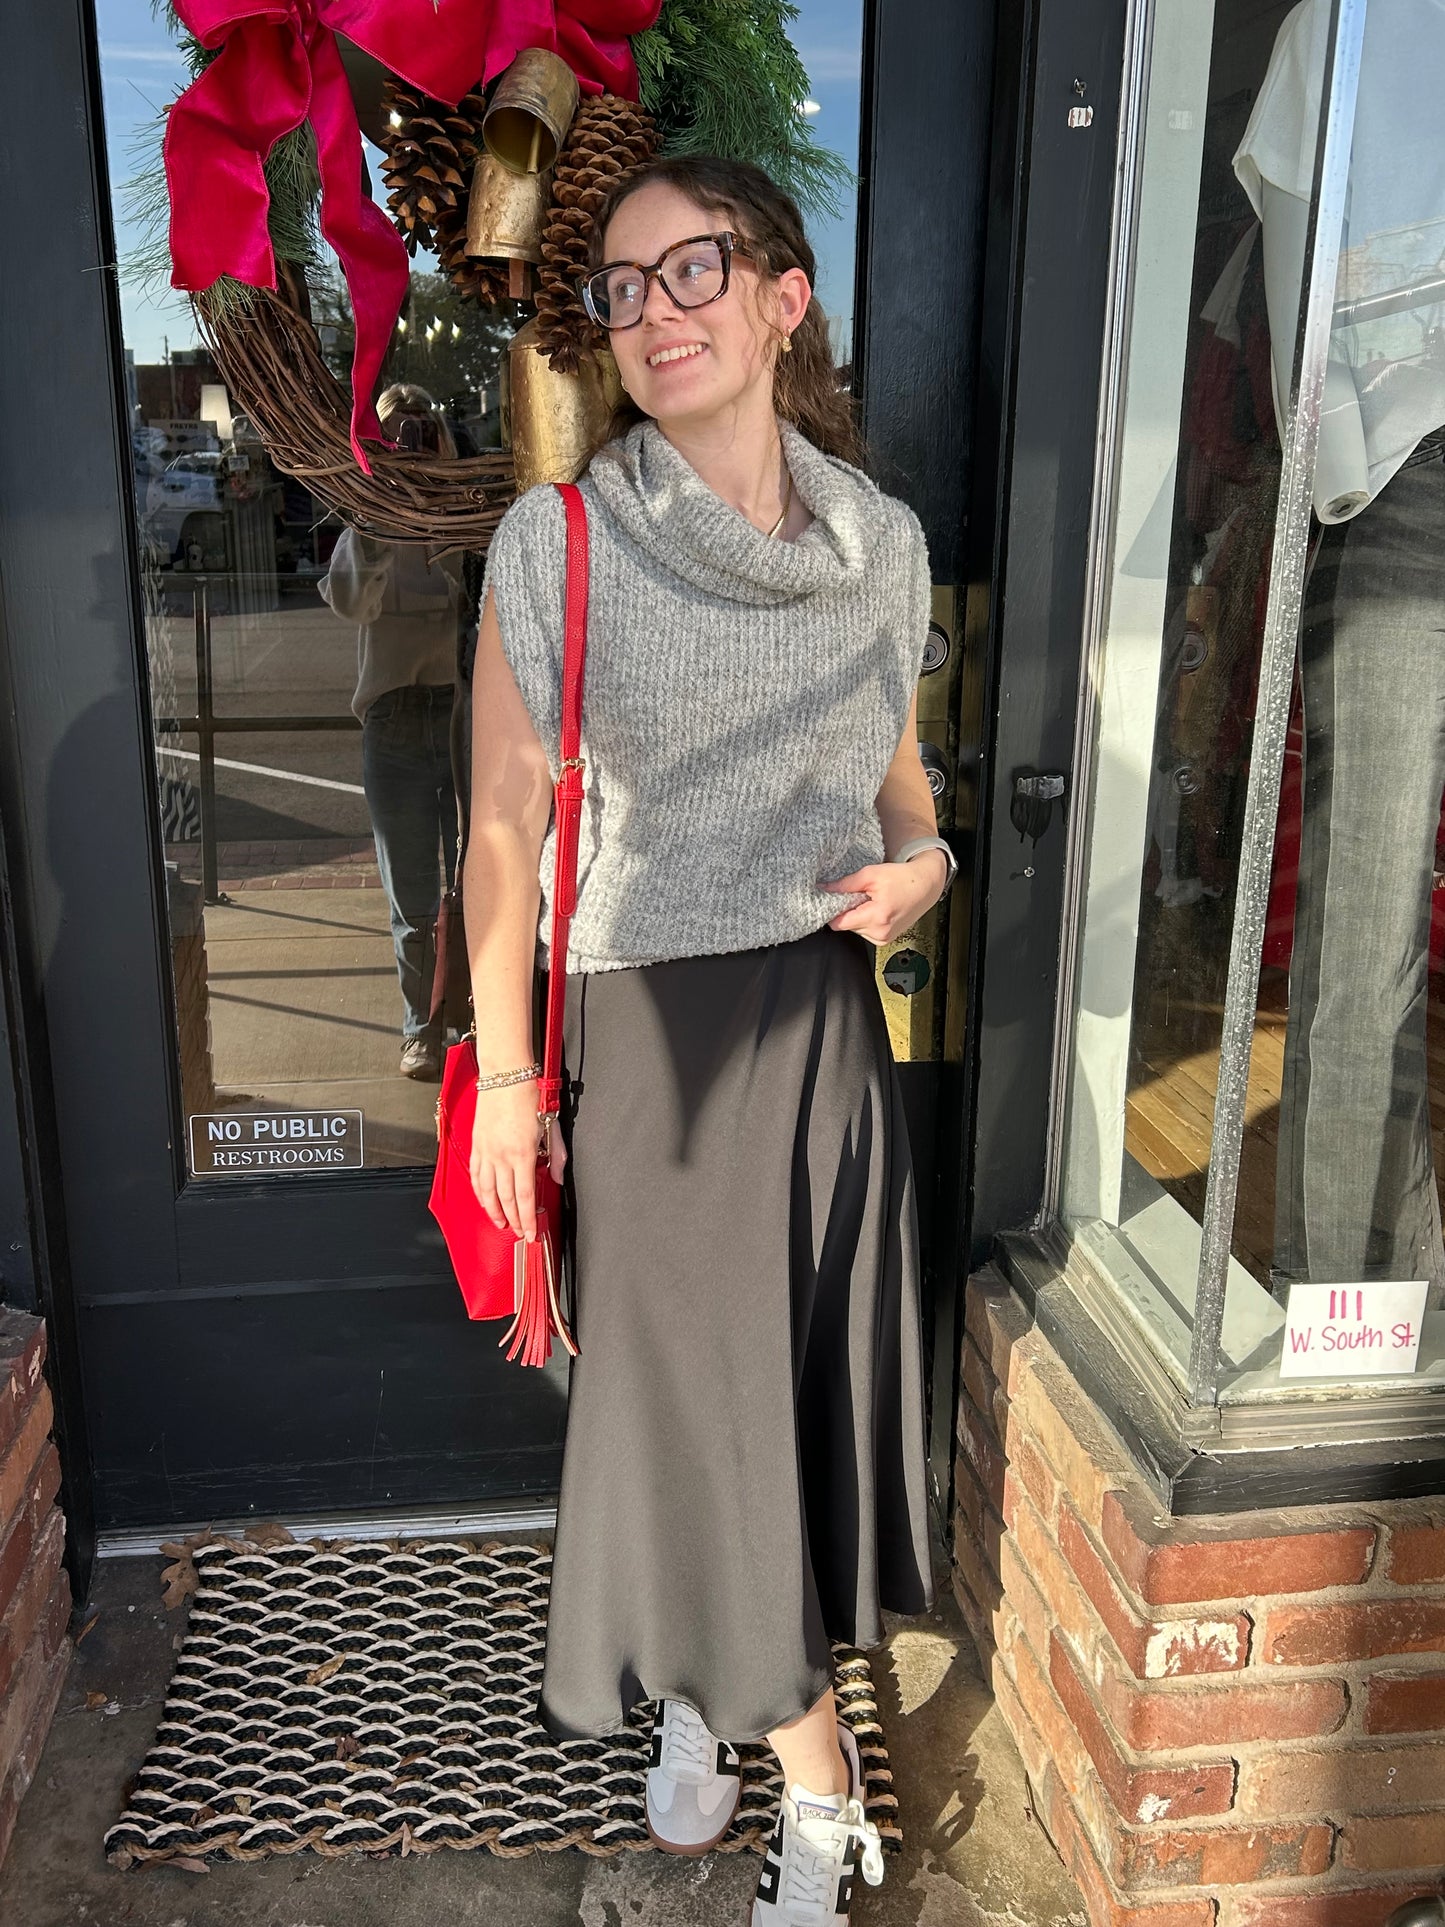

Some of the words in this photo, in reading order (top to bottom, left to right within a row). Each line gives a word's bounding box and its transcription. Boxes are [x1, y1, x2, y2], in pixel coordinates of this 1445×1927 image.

[208, 1120, 241, 1141] NO
[253, 1117, 347, 1139] PUBLIC
[212, 1148, 345, 1166] RESTROOMS
[1329, 1290, 1362, 1321] 111
[1290, 1327, 1315, 1353] W.
[1321, 1325, 1382, 1351] South
[1391, 1322, 1416, 1348] St.
